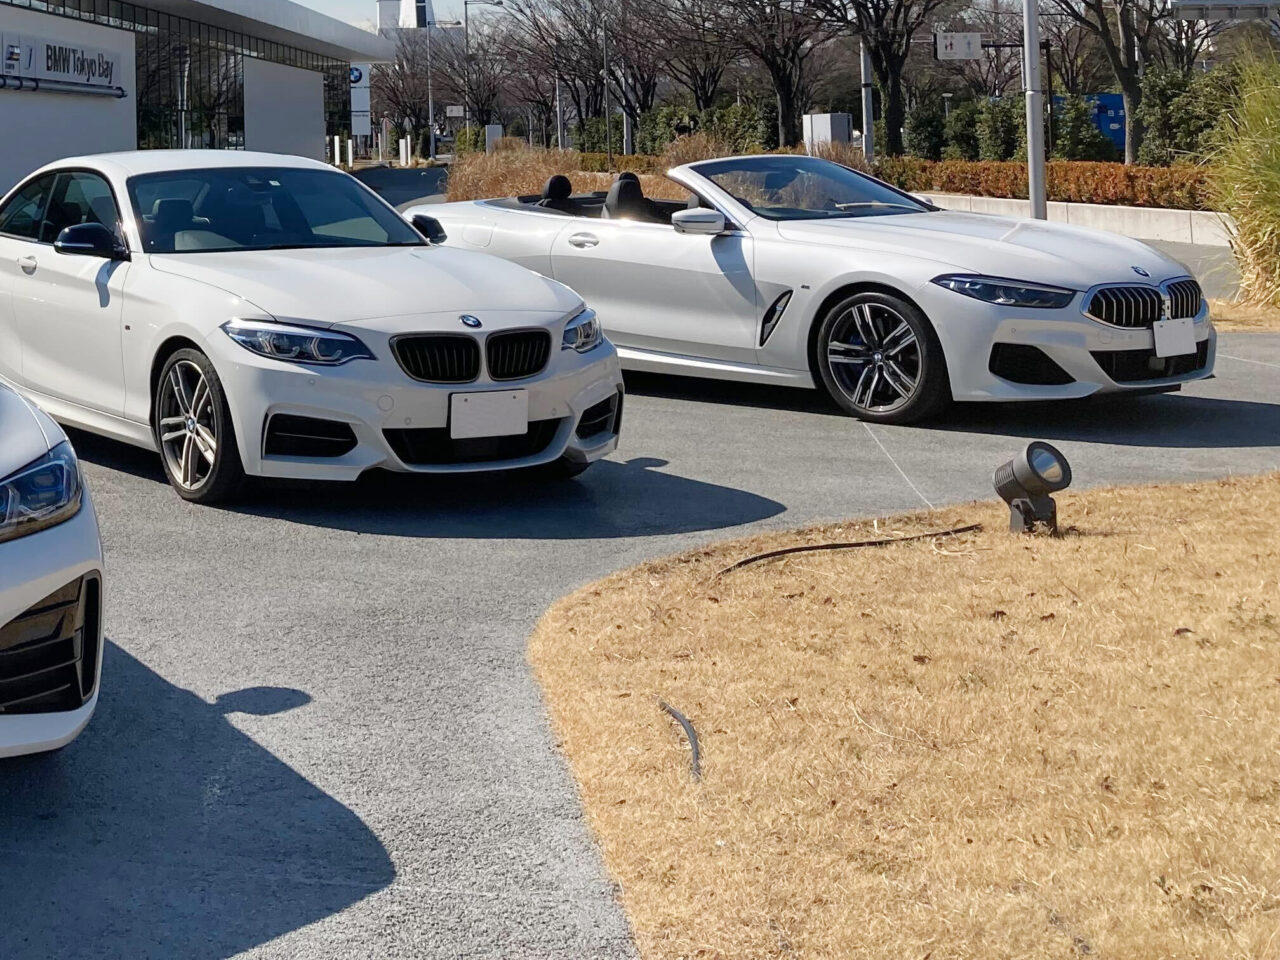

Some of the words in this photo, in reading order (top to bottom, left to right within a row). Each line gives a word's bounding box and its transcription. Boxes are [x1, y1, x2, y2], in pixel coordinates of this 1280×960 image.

[46, 44, 70, 73] BMW
[71, 48, 96, 82] Tokyo
[98, 53, 113, 84] Bay
